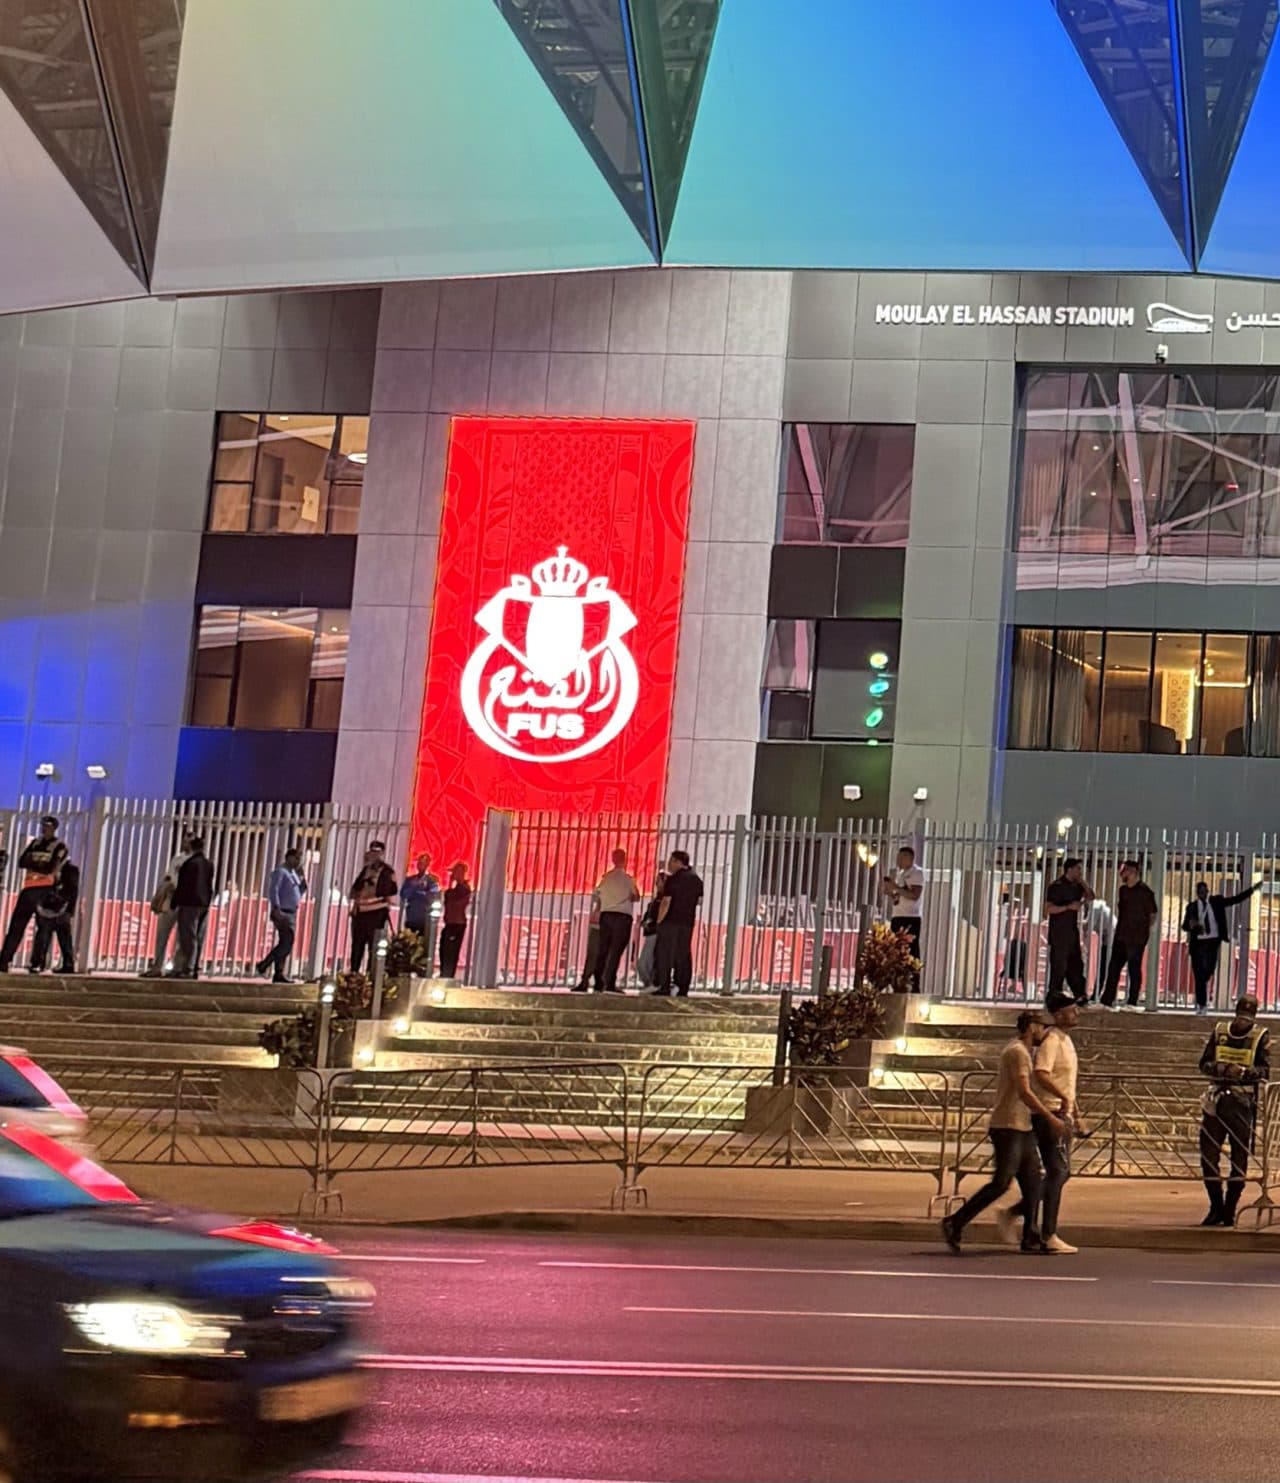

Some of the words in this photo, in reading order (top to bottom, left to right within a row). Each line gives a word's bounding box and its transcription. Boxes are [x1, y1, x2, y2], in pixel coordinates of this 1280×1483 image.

[875, 304, 949, 323] MOULAY
[952, 305, 975, 323] EL
[978, 306, 1051, 325] HASSAN
[1054, 307, 1135, 326] STADIUM
[506, 713, 585, 739] FUS
